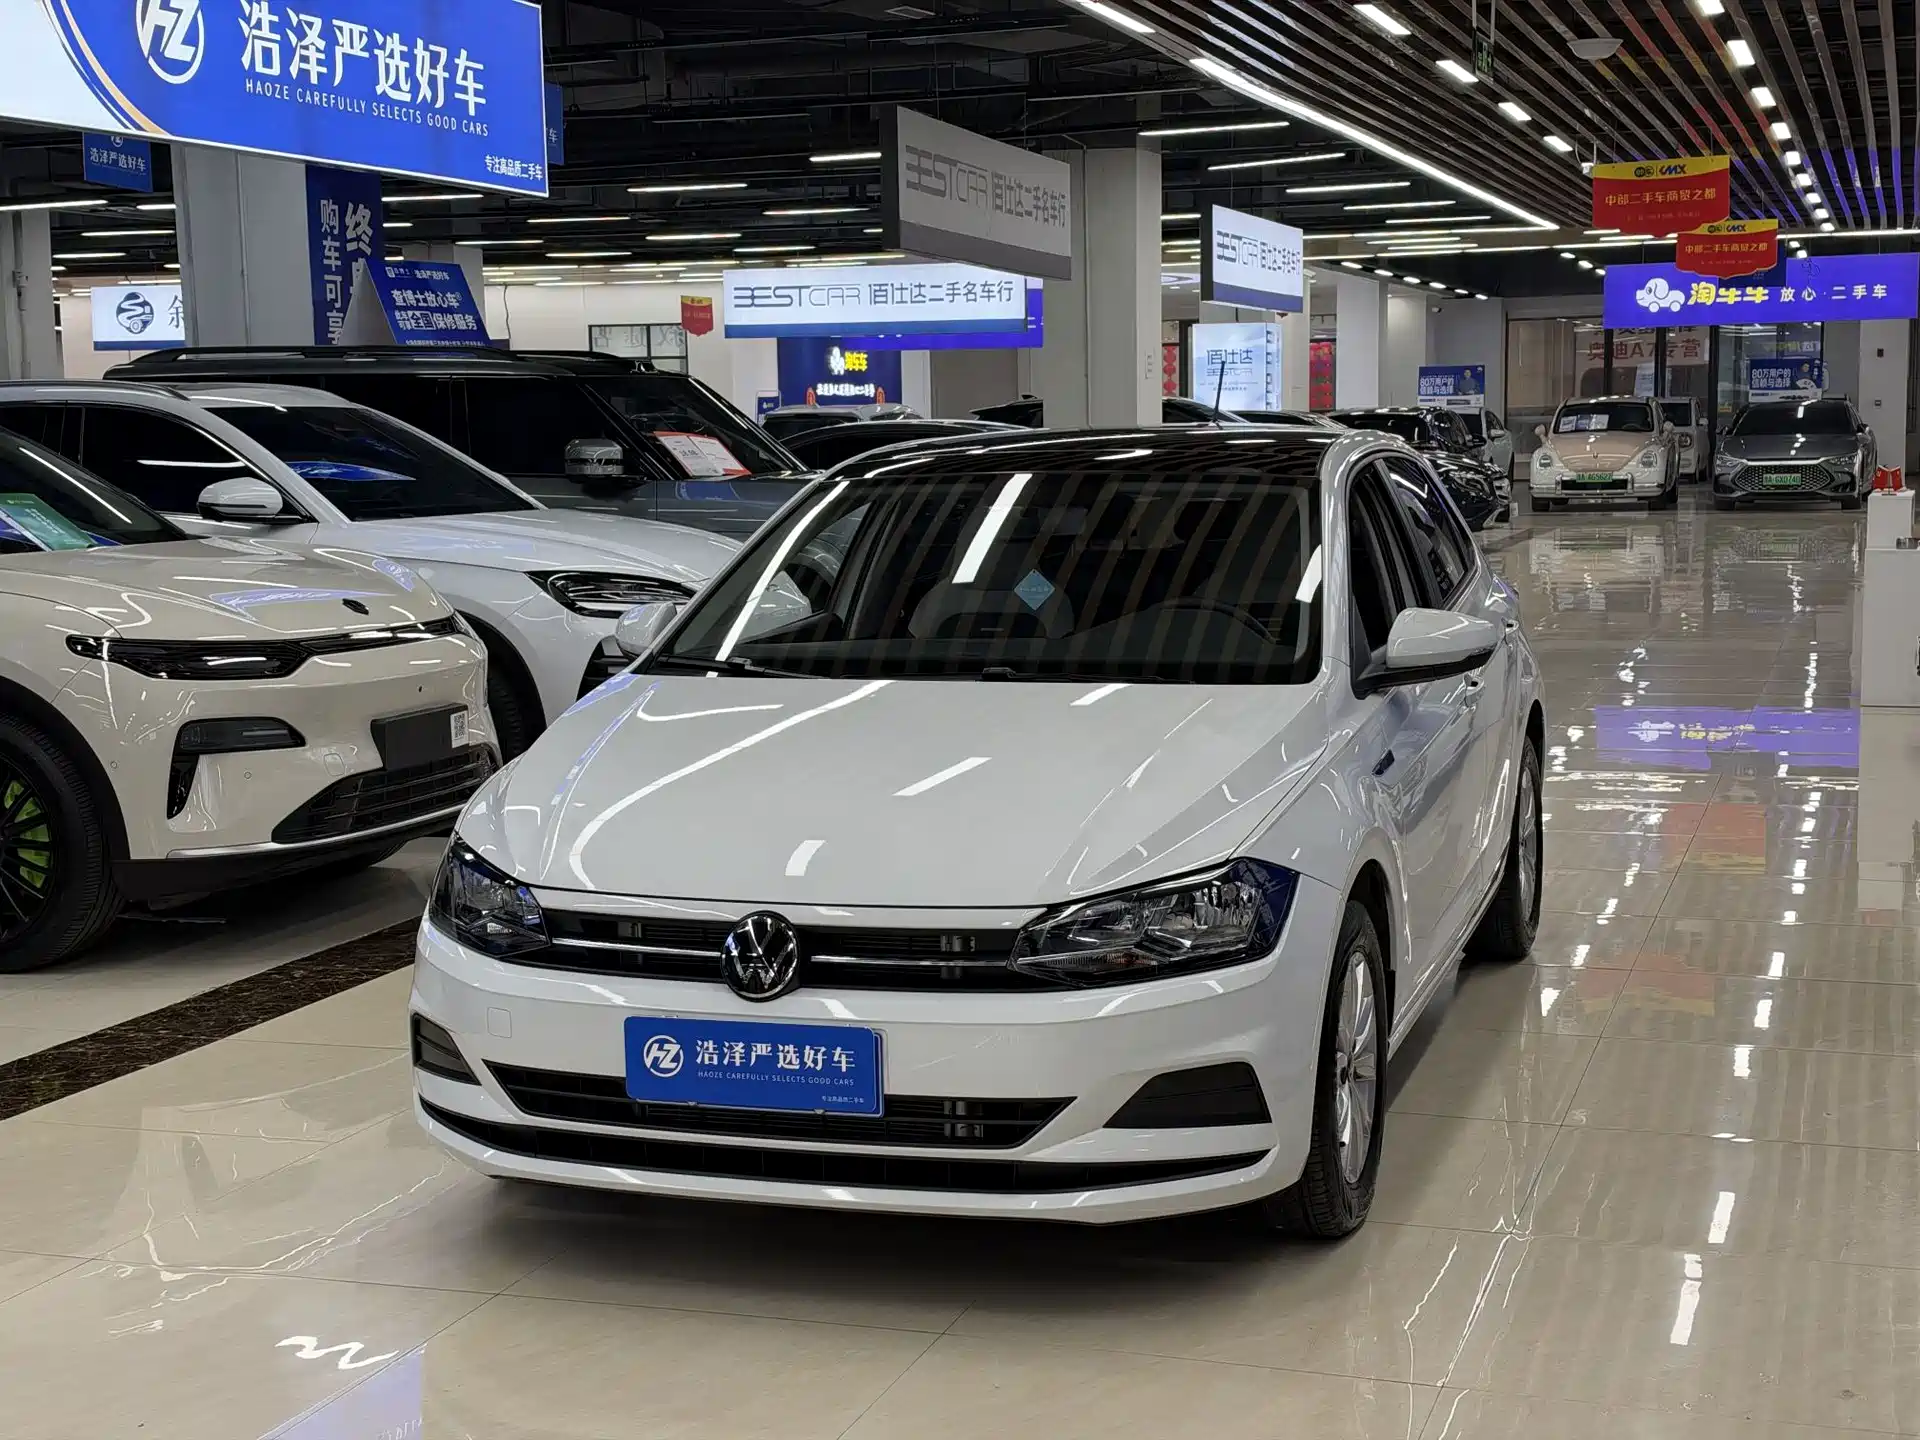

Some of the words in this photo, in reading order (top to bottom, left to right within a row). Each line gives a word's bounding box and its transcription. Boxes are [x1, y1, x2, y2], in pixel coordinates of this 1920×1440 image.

[239, 0, 486, 116] 浩泽严选好车
[246, 79, 290, 100] HAOZE
[296, 88, 366, 114] CAREFULLY
[372, 102, 422, 124] SELECTS
[427, 112, 457, 131] GOOD
[462, 119, 489, 137] CARS
[89, 147, 147, 172] 浩泽严选好车
[484, 154, 543, 180] 专注高品质二手车
[1605, 187, 1716, 207] 中部二手车商贸之都
[1685, 242, 1768, 254] 中部二手车商贸之都
[320, 199, 344, 345] 购车可享
[733, 282, 861, 308] BESTCAR
[868, 280, 1014, 305] 佰仕达二手名车行
[1206, 348, 1253, 366] 佰仕达
[1752, 368, 1791, 378] 80万用户的
[696, 1039, 856, 1072] 浩泽严选好车
[698, 1071, 723, 1079] HAOZE
[726, 1072, 769, 1081] CAREFULLY
[772, 1074, 806, 1083] SELECTS
[808, 1076, 831, 1085] GOOD
[834, 1078, 854, 1086] CARS
